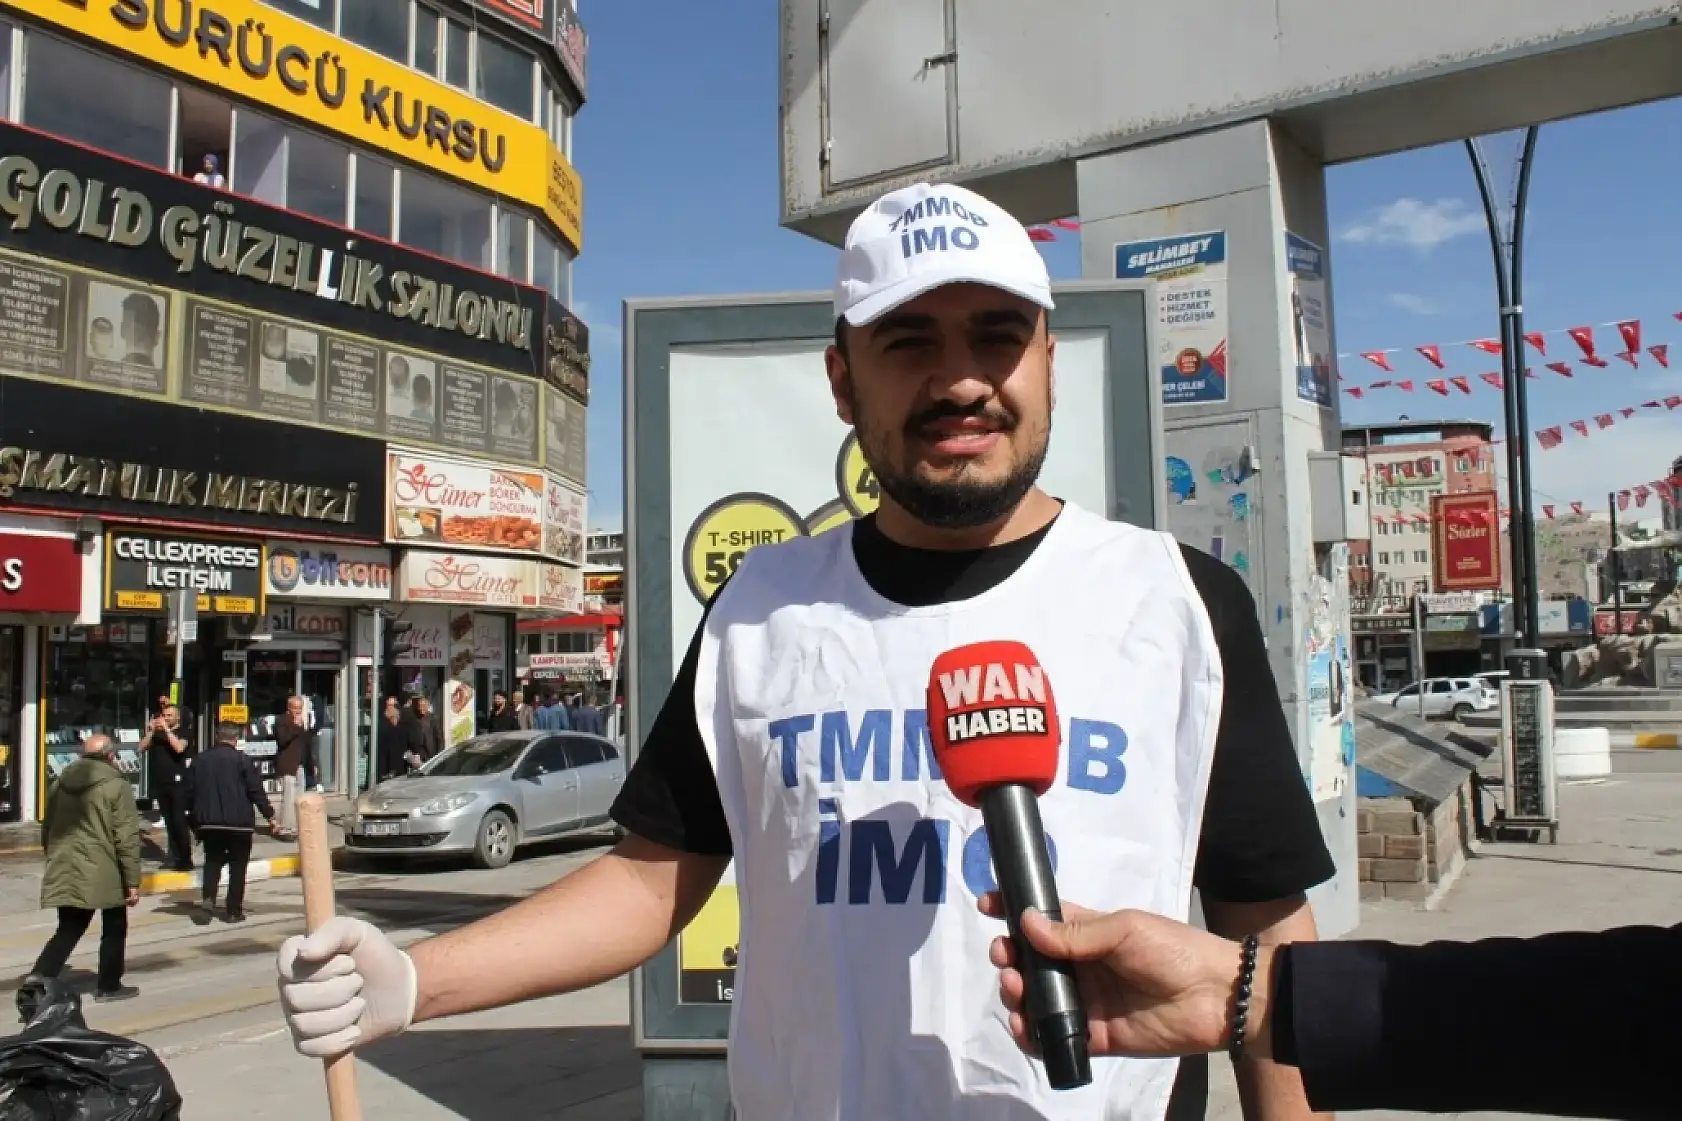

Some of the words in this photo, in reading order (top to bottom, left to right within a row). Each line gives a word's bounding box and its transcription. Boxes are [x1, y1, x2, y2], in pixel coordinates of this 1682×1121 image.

[360, 78, 506, 173] KURSU
[889, 196, 989, 233] TMMOB
[0, 155, 153, 246] GOLD
[160, 200, 384, 312] GÜZELLİK
[389, 270, 533, 349] SALONU
[901, 225, 980, 259] İMO
[1166, 288, 1212, 302] DESTEK
[202, 472, 358, 524] MERKEZİ
[115, 537, 260, 568] CELLEXPRESS
[708, 529, 785, 547] T-SHIRT
[146, 561, 233, 594] İLETİŞİM
[938, 664, 1047, 709] WAN
[946, 706, 1046, 742] HABER
